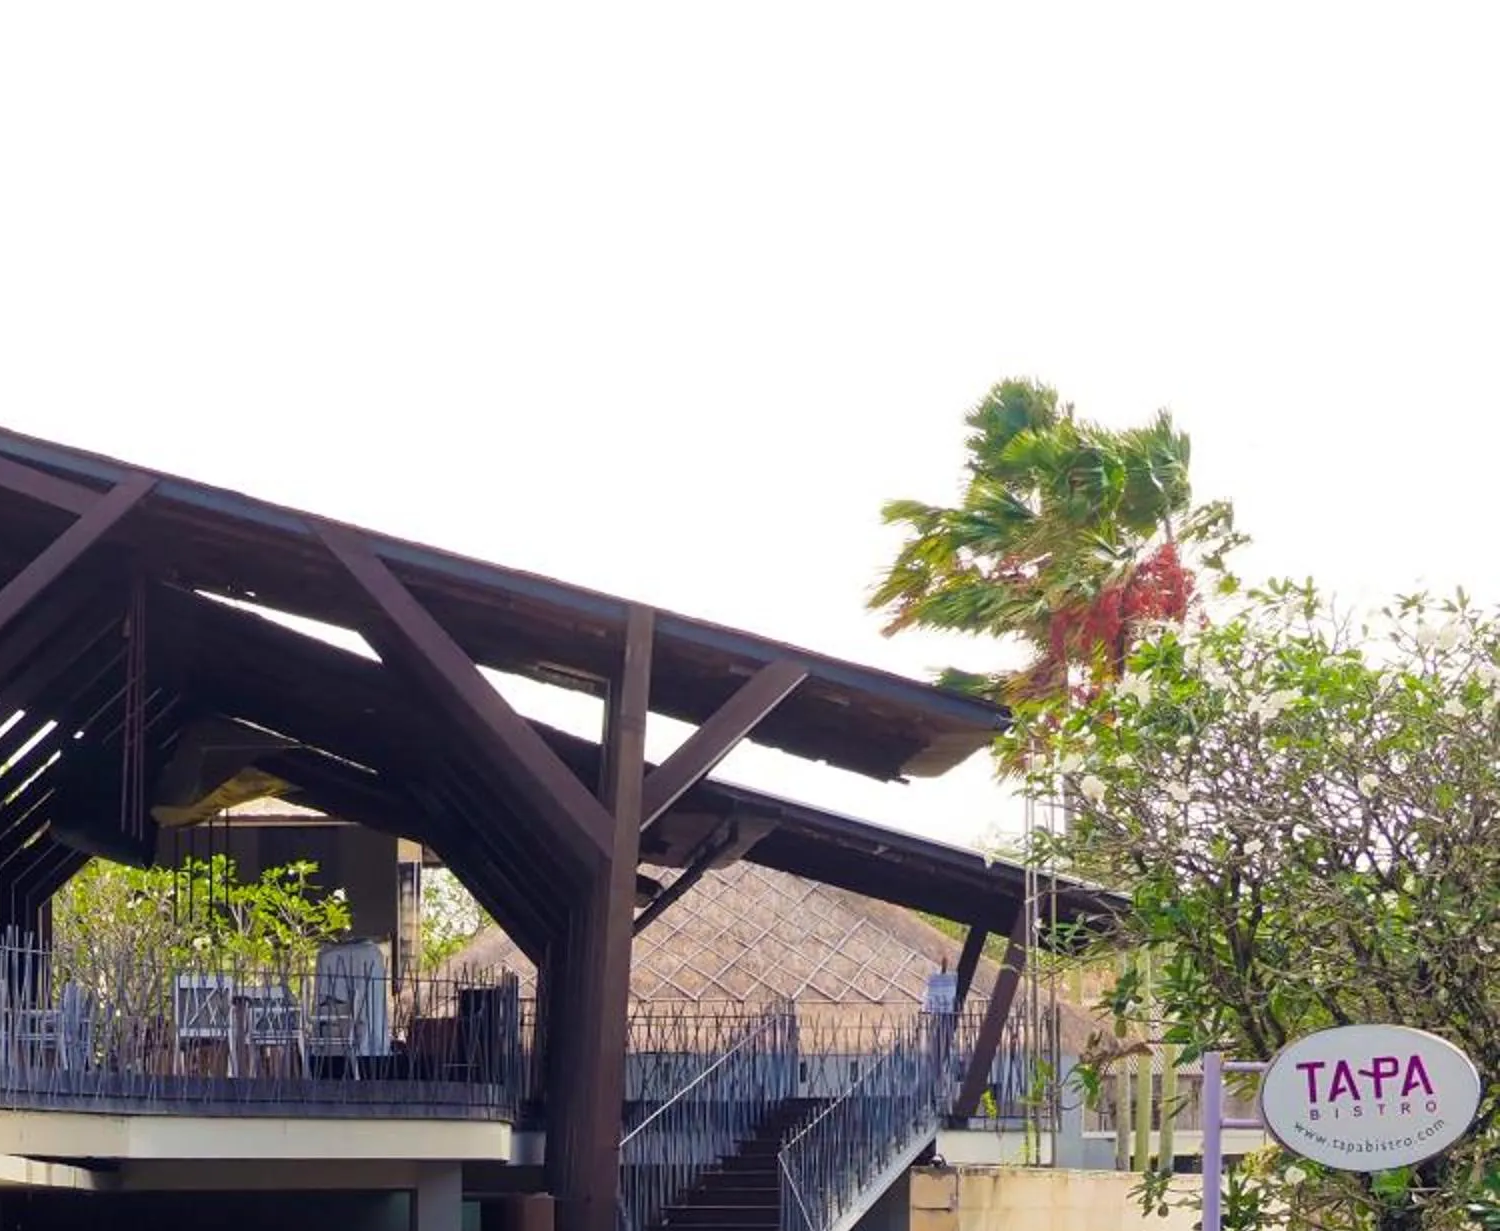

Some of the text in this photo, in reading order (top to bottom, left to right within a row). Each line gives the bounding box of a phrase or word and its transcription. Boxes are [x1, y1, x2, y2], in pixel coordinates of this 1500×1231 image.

[1296, 1055, 1433, 1104] TAPA
[1309, 1100, 1438, 1121] BISTRO
[1294, 1118, 1445, 1154] www.tapabistro.com
